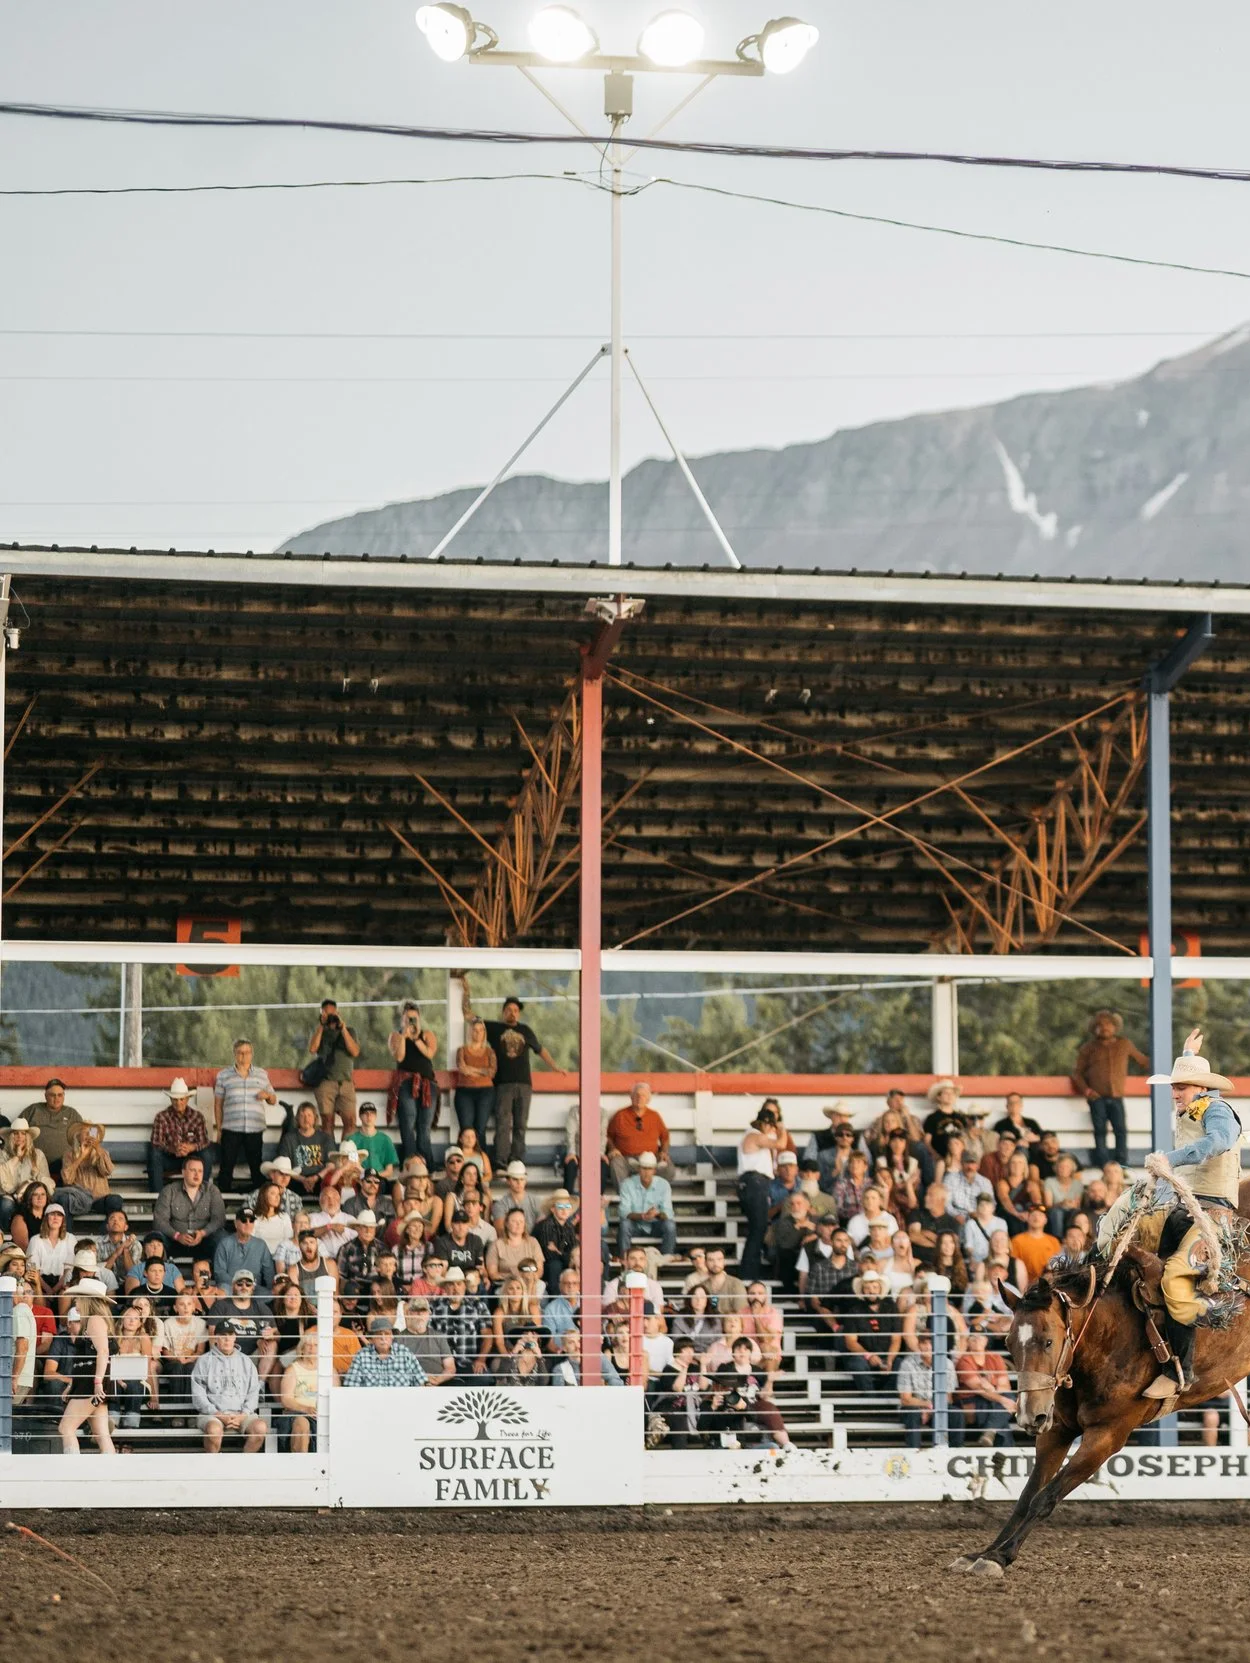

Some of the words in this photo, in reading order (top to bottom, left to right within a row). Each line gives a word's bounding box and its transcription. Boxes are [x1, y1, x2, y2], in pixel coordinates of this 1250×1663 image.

[521, 1429, 533, 1438] for
[536, 1428, 552, 1440] Life
[419, 1446, 555, 1471] SURFACE
[947, 1455, 1072, 1479] CHI
[1087, 1454, 1249, 1478] OSEPH
[434, 1477, 550, 1501] FAMILY
